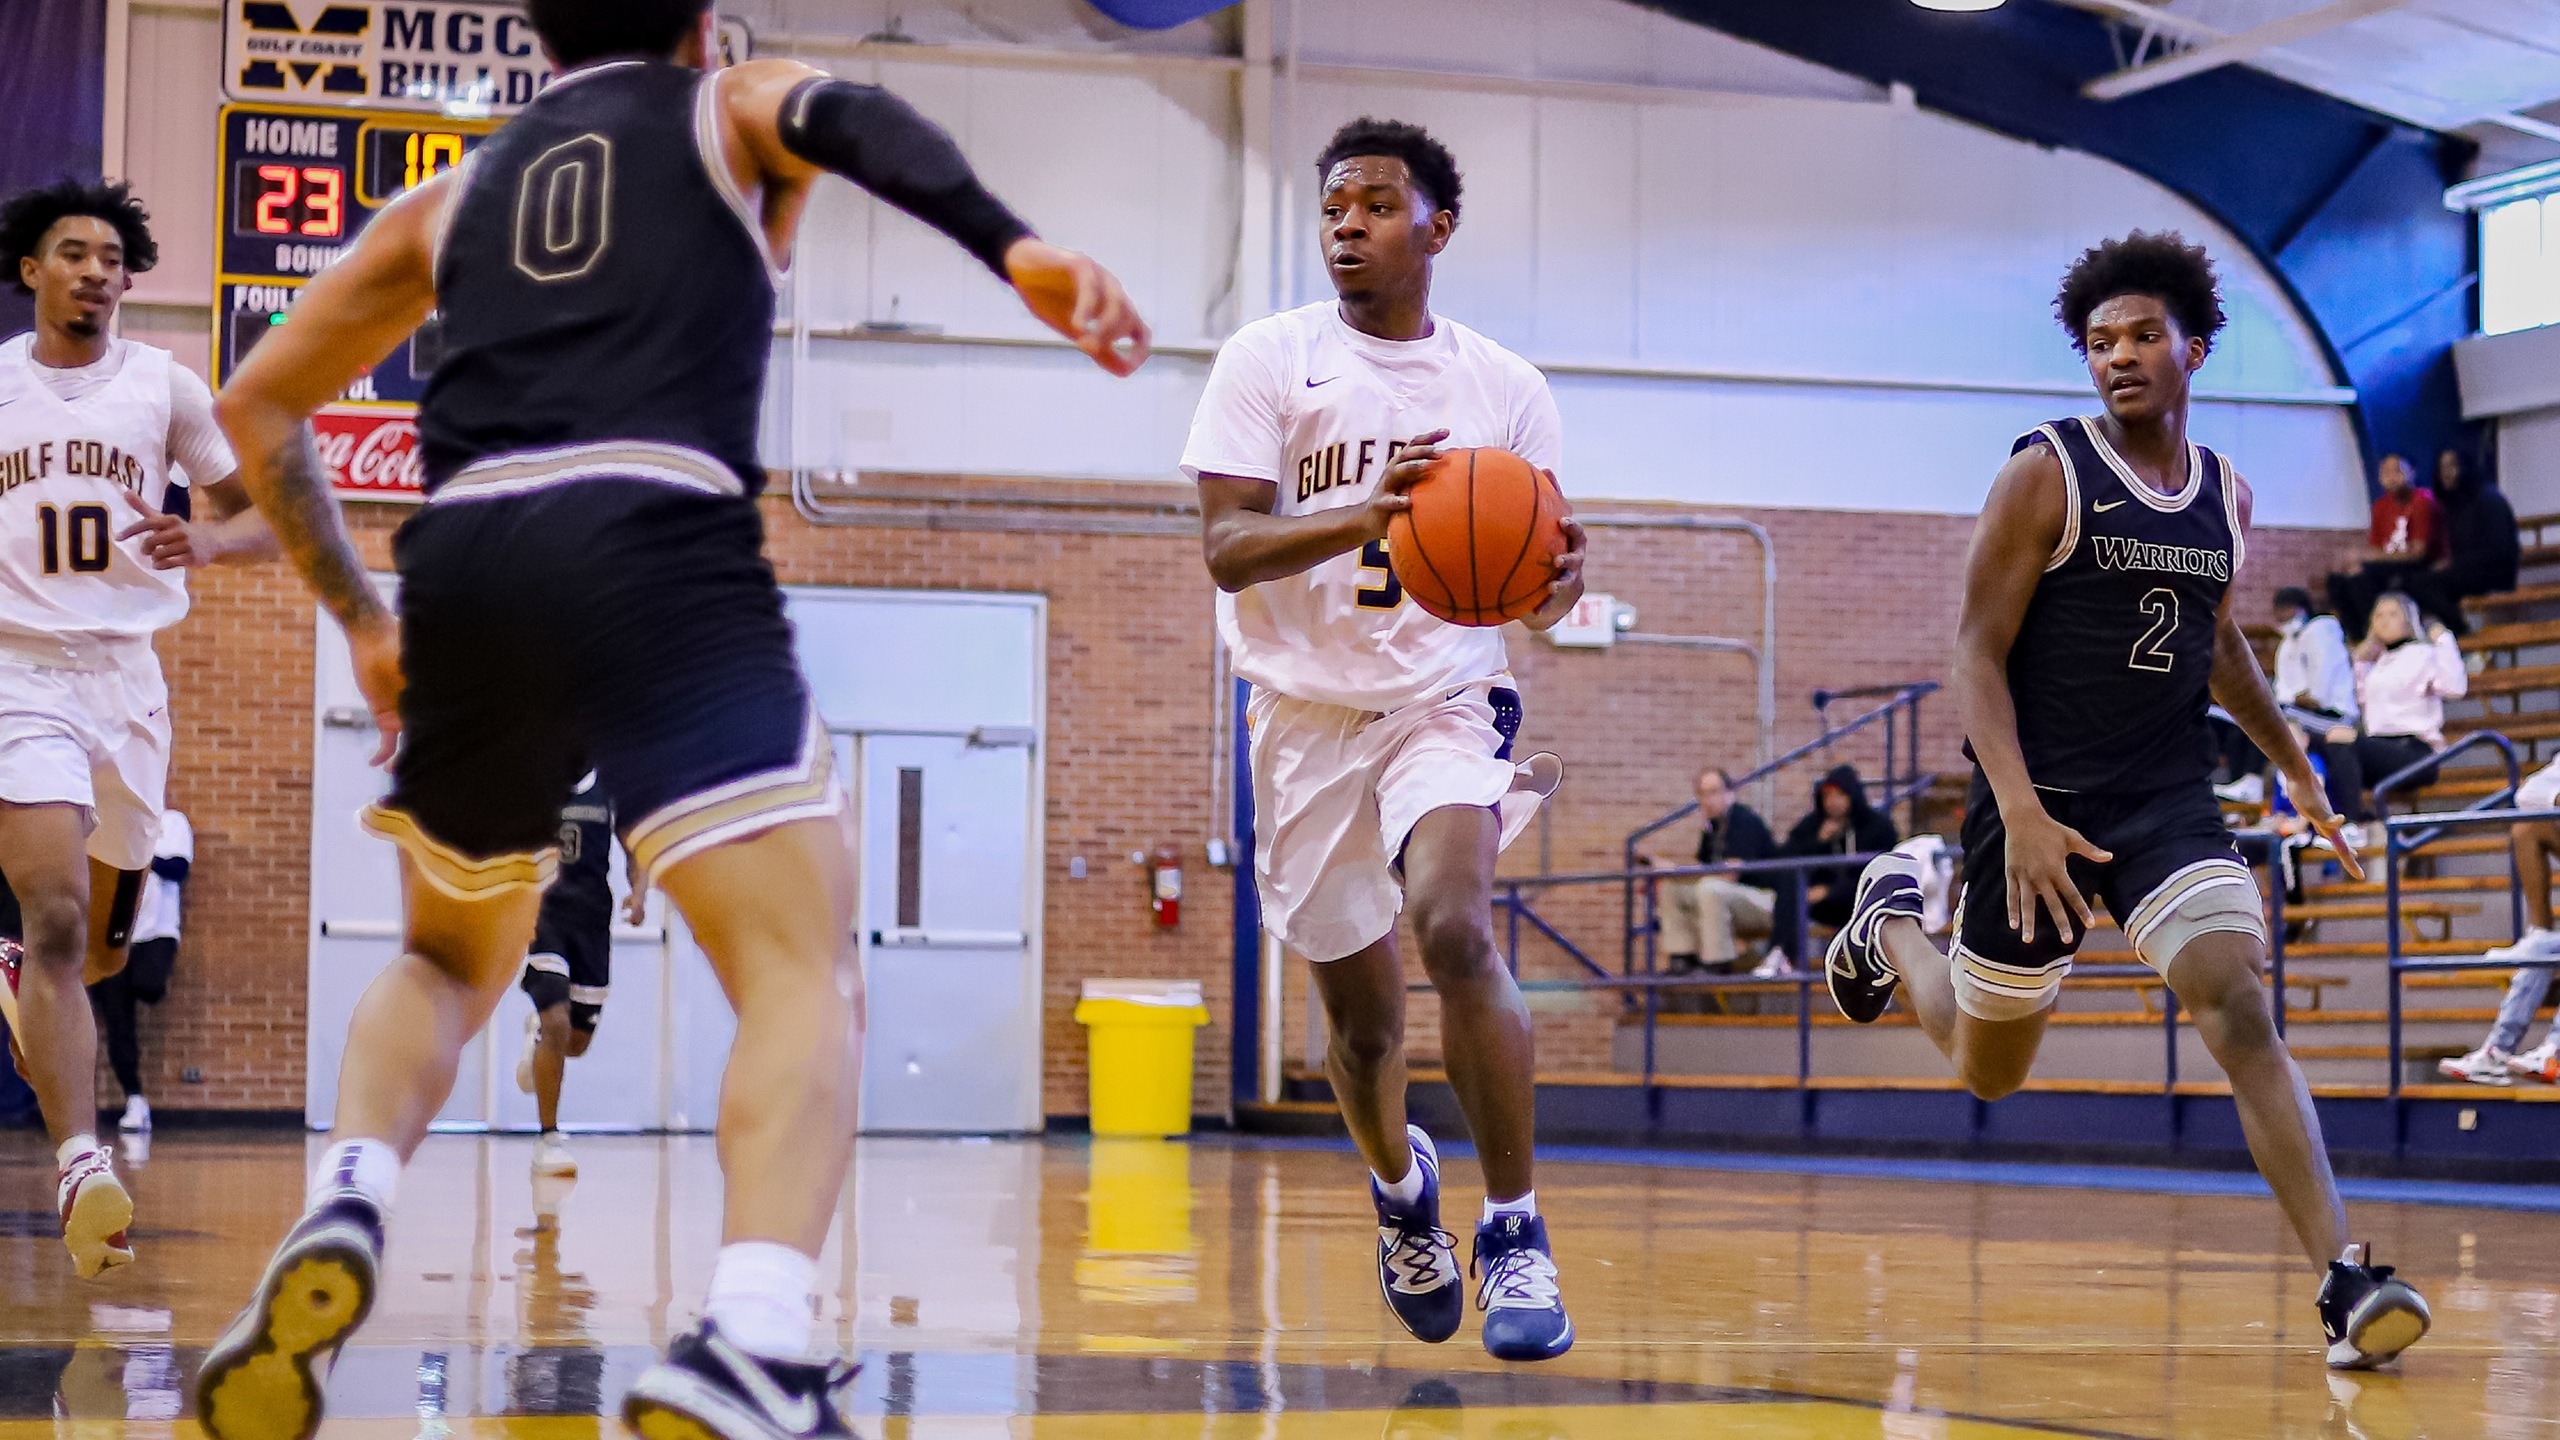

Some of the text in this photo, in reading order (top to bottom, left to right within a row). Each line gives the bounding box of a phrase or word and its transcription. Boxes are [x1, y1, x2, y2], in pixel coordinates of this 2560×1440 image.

[383, 9, 533, 56] MGC
[380, 61, 552, 105] BULLD
[245, 118, 338, 158] HOME
[256, 165, 343, 236] 23
[514, 133, 611, 281] 0
[1297, 438, 1376, 503] GULF
[36, 501, 112, 577] 10
[2128, 588, 2179, 672] 2
